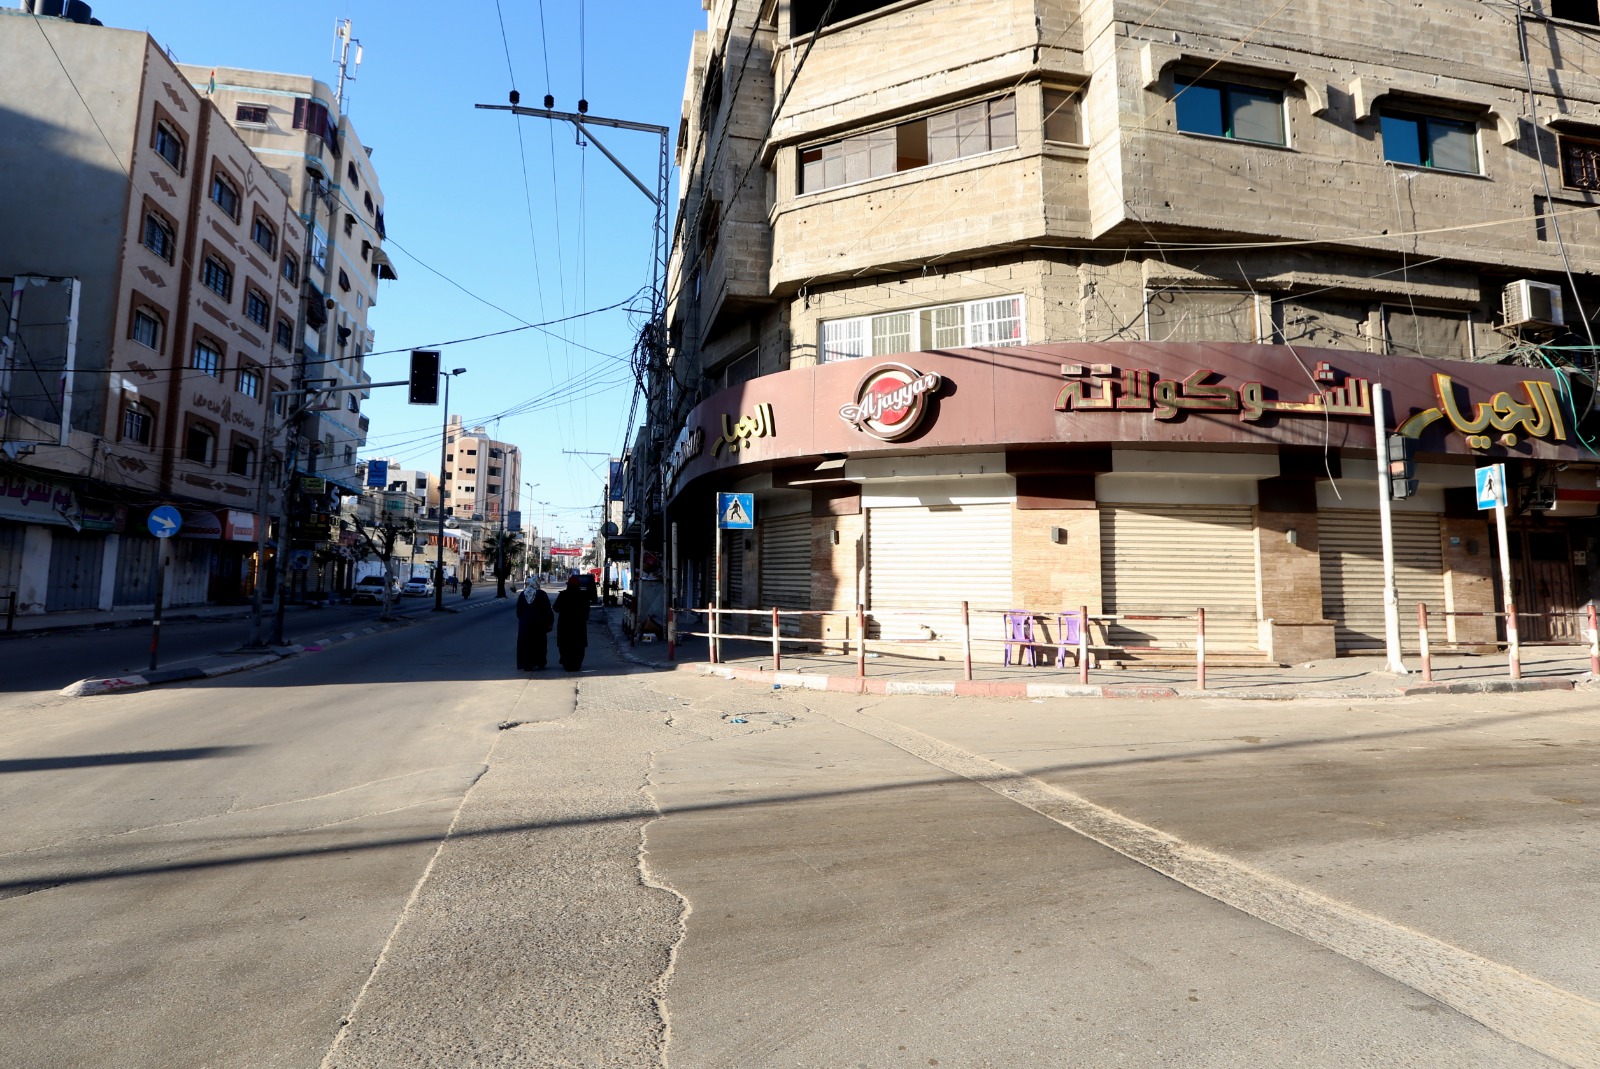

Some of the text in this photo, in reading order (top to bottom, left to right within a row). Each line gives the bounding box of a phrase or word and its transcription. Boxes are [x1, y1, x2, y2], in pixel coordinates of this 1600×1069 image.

[710, 403, 775, 456] الجيار
[1054, 361, 1567, 449] الجيار للشوكولاتة
